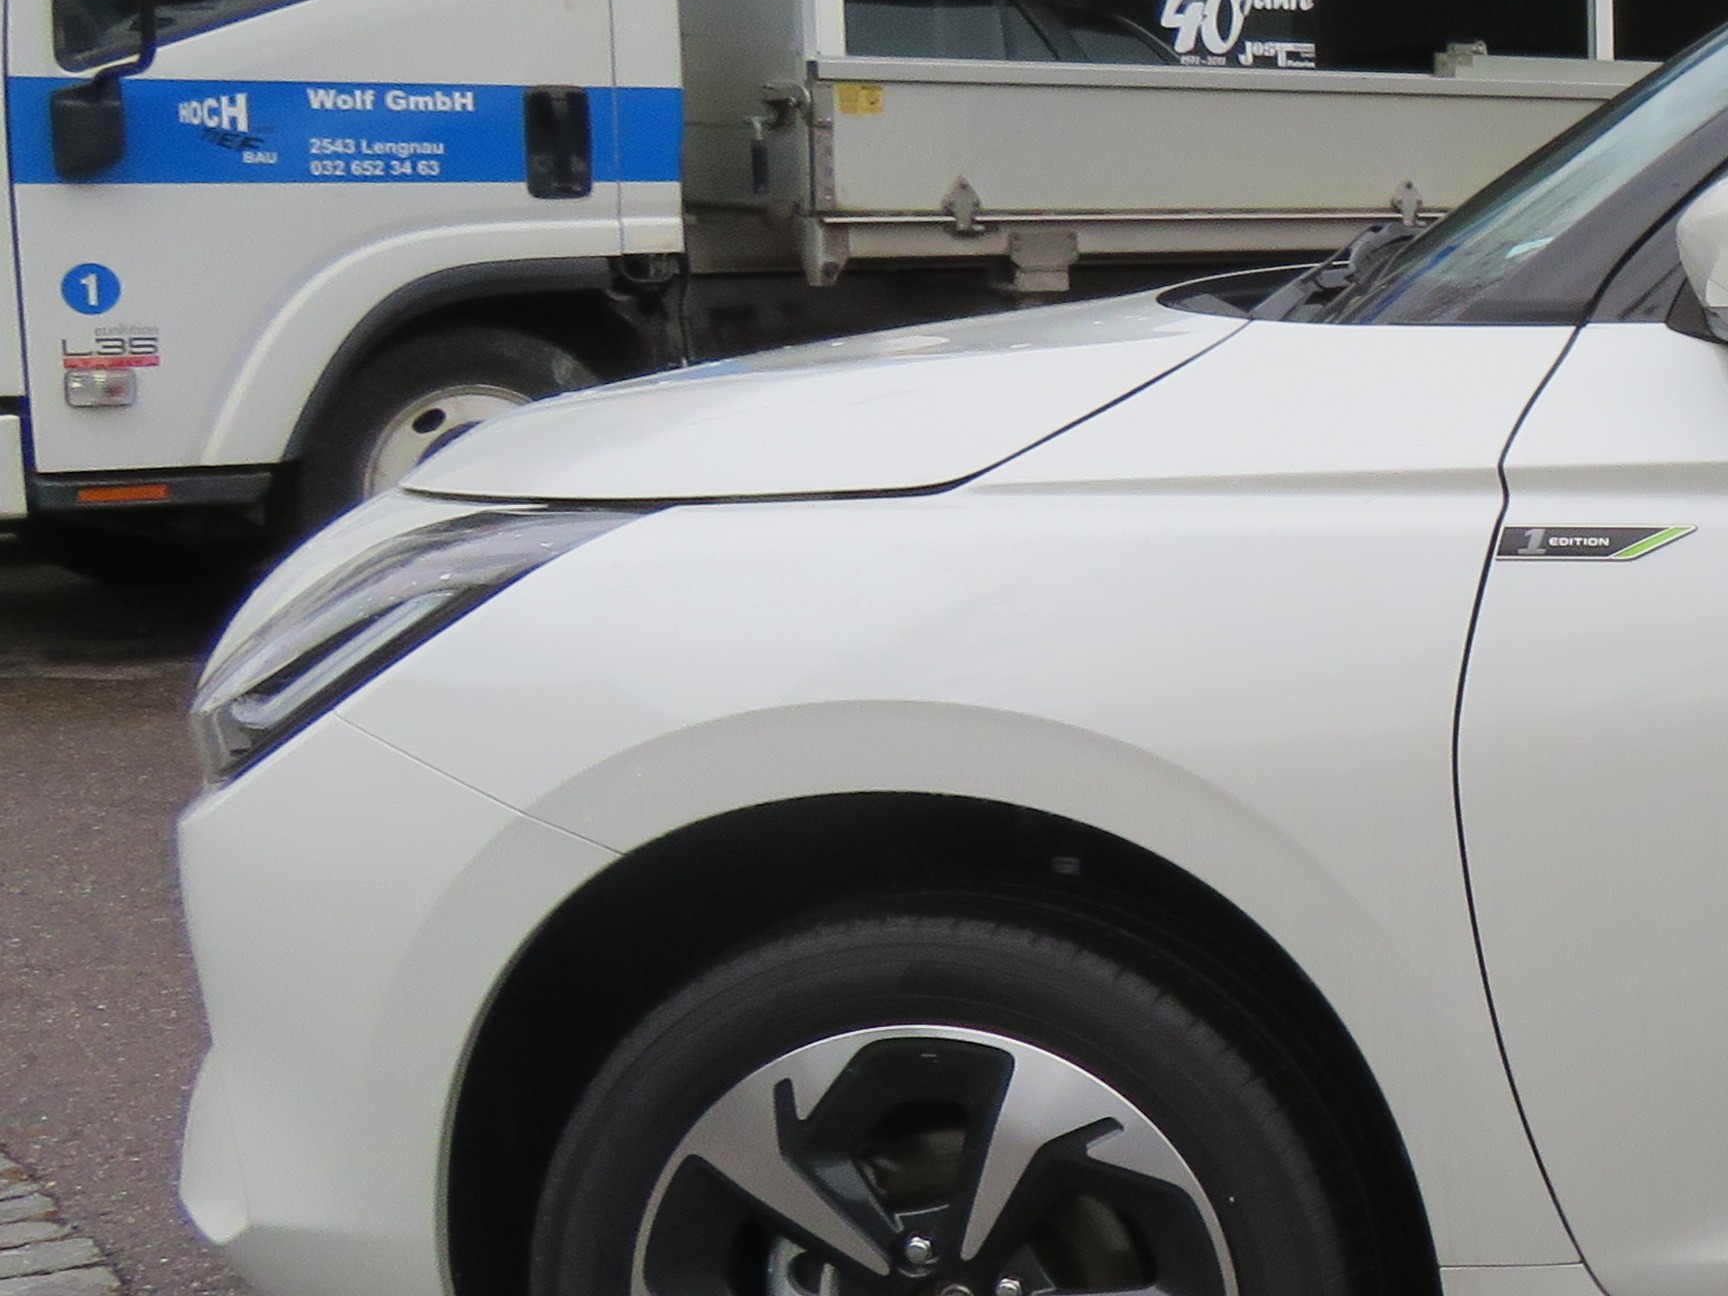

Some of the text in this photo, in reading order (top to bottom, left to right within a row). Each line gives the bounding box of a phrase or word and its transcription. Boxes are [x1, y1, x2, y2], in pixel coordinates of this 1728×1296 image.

[306, 88, 475, 112] Wolf GmbH
[178, 92, 248, 133] HOCH
[242, 150, 279, 164] BAU
[309, 138, 444, 158] 2543 Lengnau
[310, 161, 441, 176] 032 652 34 63
[80, 273, 99, 306] 1
[61, 336, 159, 356] L35
[1518, 528, 1610, 554] 1 EDITION
